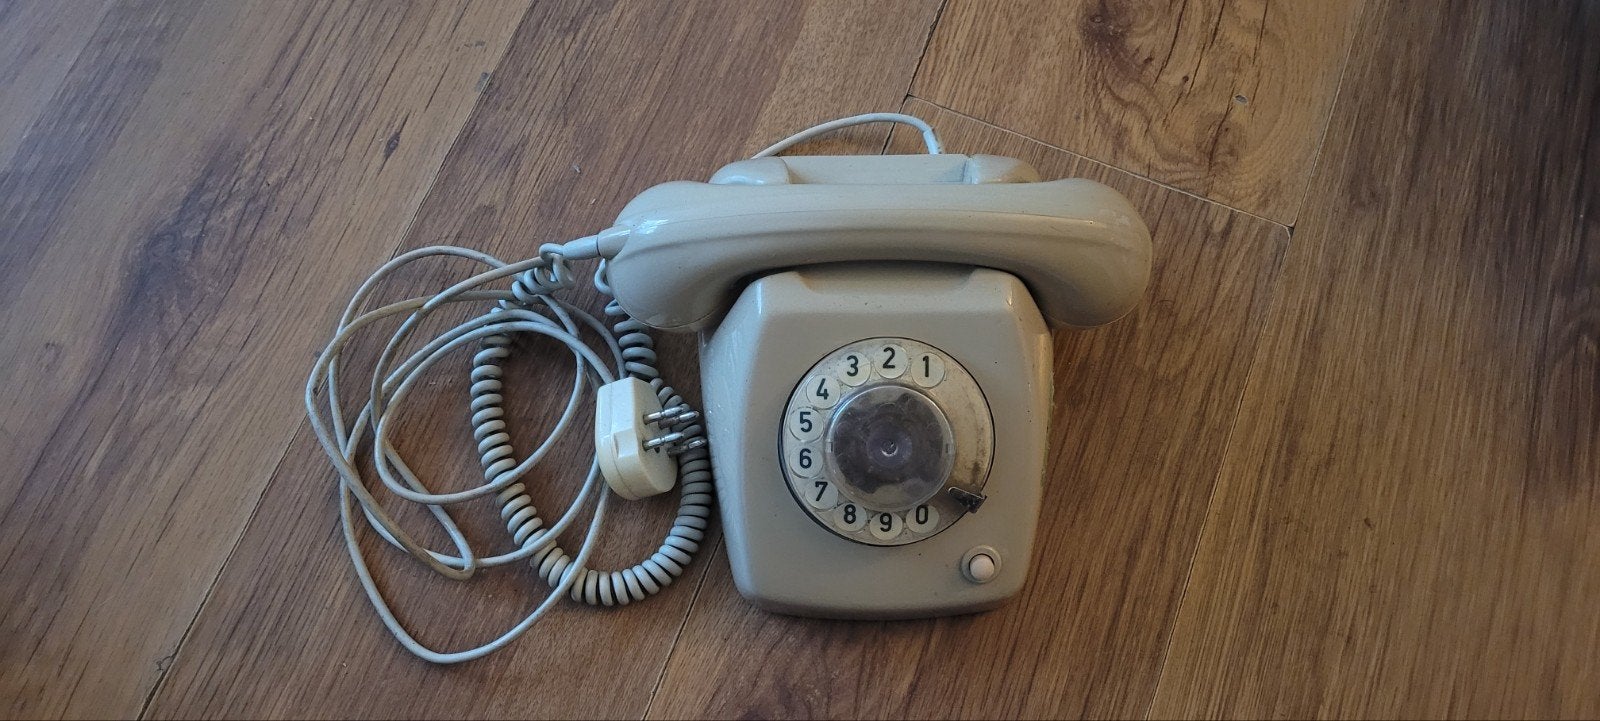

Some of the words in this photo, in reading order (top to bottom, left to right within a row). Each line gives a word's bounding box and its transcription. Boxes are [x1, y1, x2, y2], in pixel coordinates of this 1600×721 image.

[846, 354, 859, 378] 3
[882, 346, 896, 370] 2
[922, 355, 930, 378] 1
[815, 377, 830, 401] 4
[799, 410, 813, 433] 5
[799, 447, 813, 470] 6
[814, 480, 829, 502] 7
[843, 503, 857, 525] 8
[879, 512, 893, 533] 9
[915, 503, 929, 526] 0
